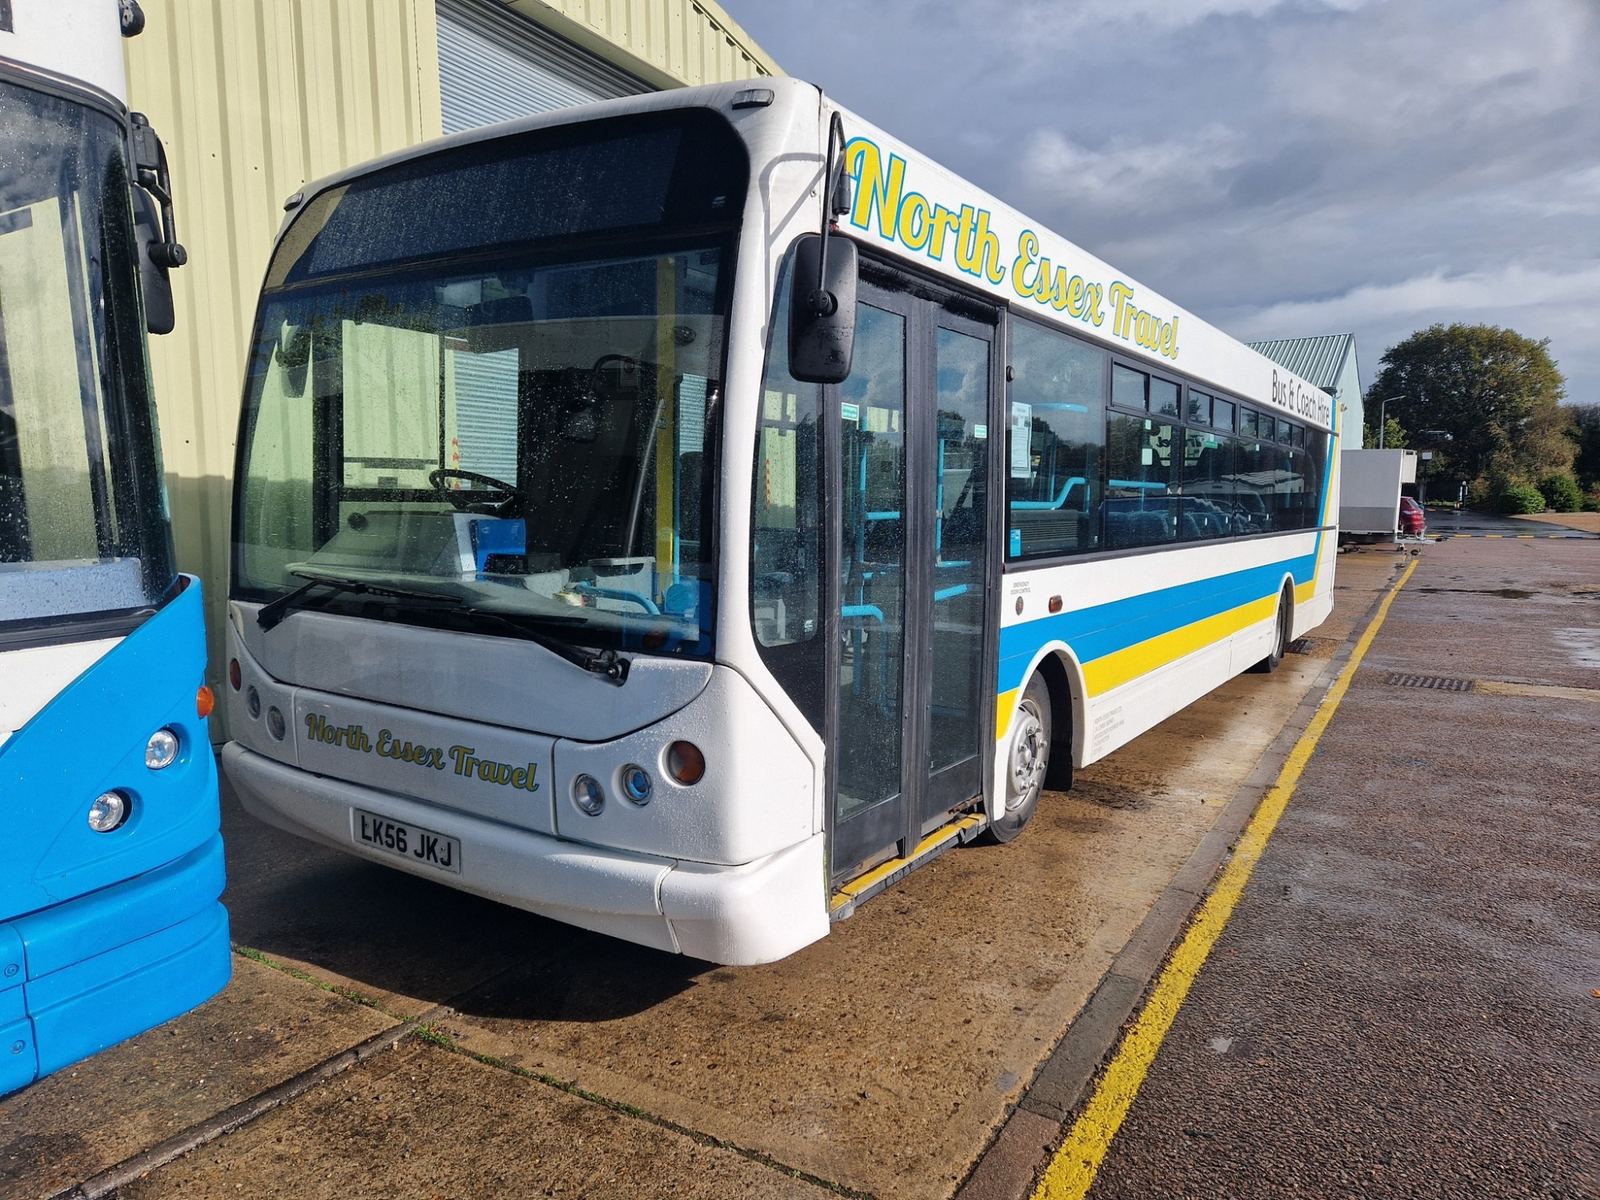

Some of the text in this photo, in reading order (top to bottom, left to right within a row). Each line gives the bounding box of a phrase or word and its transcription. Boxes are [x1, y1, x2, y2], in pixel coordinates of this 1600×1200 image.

[845, 136, 1180, 360] North Essex Travel
[1272, 368, 1330, 426] Bus & Coach Hire
[304, 712, 541, 793] North Essex Travel
[360, 814, 453, 867] LK56 JKJ
